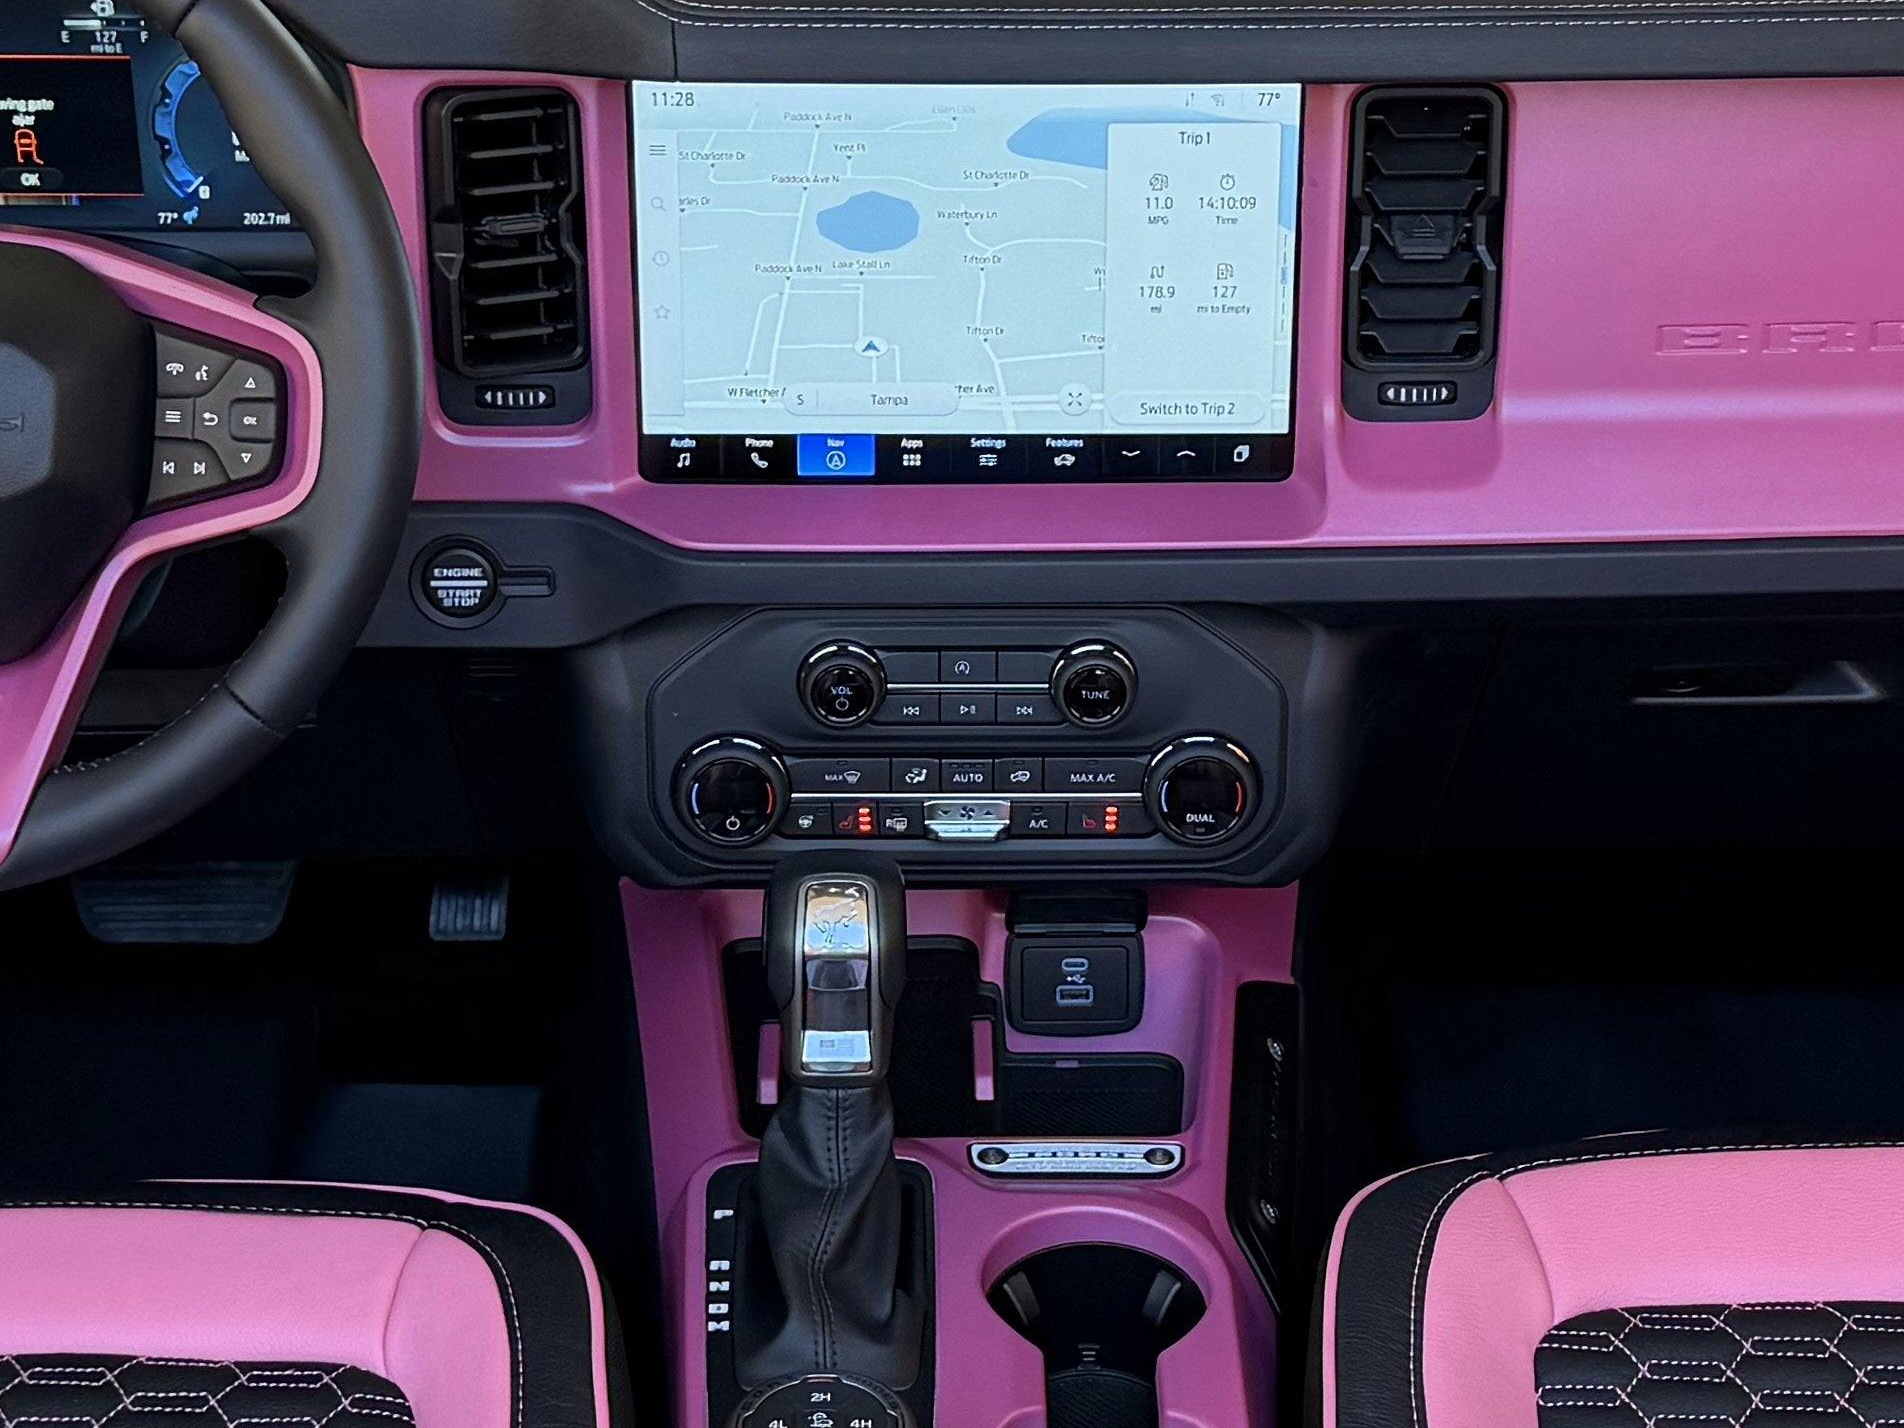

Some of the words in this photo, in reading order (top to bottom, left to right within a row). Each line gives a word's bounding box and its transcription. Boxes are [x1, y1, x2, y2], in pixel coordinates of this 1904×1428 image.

[61, 31, 70, 43] E
[94, 31, 117, 43] 127
[140, 31, 149, 43] F
[651, 91, 695, 107] 11:28
[1258, 92, 1281, 107] 77°
[784, 111, 823, 122] Paddock
[825, 111, 844, 122] Ave
[846, 111, 853, 121] N
[1178, 132, 1204, 146] Trip
[692, 151, 734, 161] Charlotte
[20, 172, 41, 186] OK
[771, 174, 811, 184] Paddock
[812, 174, 830, 183] Ave
[832, 174, 840, 183] N
[963, 170, 973, 180] St
[974, 170, 1018, 180] Charlotte
[1144, 197, 1174, 210] 11.0
[1198, 196, 1257, 210] 14:10:09
[157, 212, 179, 224] 77°
[937, 210, 984, 221] Waterbury
[986, 210, 998, 219] Ln
[1148, 216, 1169, 225] MPG
[1215, 216, 1239, 225] Time
[832, 260, 854, 270] Lake
[963, 255, 990, 264] Tifton
[755, 264, 794, 274] Paddock
[795, 264, 813, 273] Ave
[814, 264, 823, 273] N
[1139, 285, 1176, 299] 178.9
[1212, 285, 1237, 299] 127
[1210, 305, 1221, 314] to
[1222, 305, 1251, 315] Empty
[966, 326, 993, 336] Tifton
[728, 387, 737, 397] W
[739, 387, 778, 397] Fletcher
[796, 394, 805, 405] S
[871, 394, 909, 406] Tampa
[1140, 402, 1182, 415] Switch
[1185, 403, 1198, 415] to
[1201, 402, 1226, 417] Trip
[1227, 402, 1236, 415] 2
[745, 437, 774, 448] Phone
[827, 437, 845, 448] Nav
[900, 437, 924, 449] Apps
[970, 437, 1007, 449] Settings
[1045, 437, 1084, 448] Features
[433, 567, 484, 578] ENGINE
[437, 588, 482, 598] START
[442, 597, 479, 607] STOP
[830, 685, 853, 695] VOL
[1080, 690, 1111, 700] TUNE
[952, 773, 984, 783] AUTO
[1070, 773, 1095, 783] MAX
[1096, 773, 1116, 783] A/C
[1185, 813, 1215, 823] DUAL
[1029, 819, 1048, 829] A/C
[810, 1392, 831, 1402] 2H
